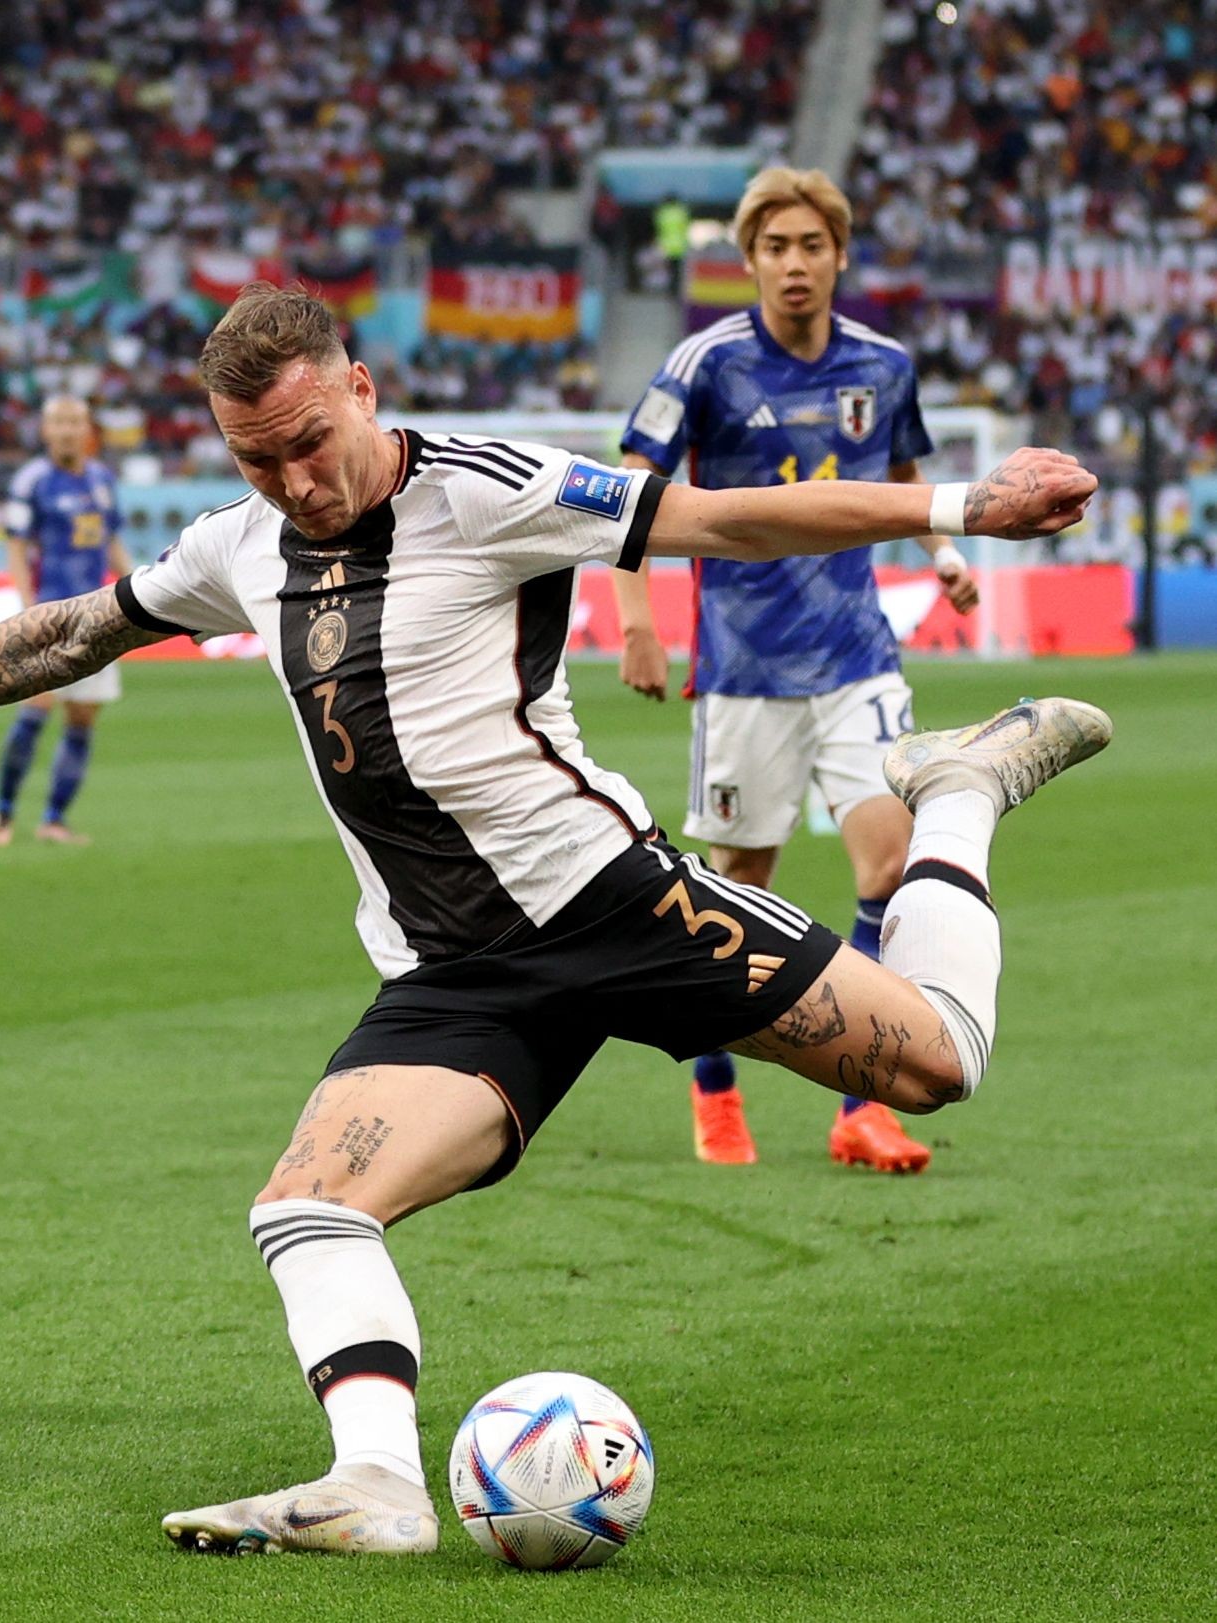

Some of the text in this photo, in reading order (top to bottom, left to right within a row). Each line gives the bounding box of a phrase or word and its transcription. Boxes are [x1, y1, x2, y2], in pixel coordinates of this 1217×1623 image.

[312, 680, 355, 774] 3
[652, 879, 744, 959] 3
[838, 1013, 887, 1101] Good
